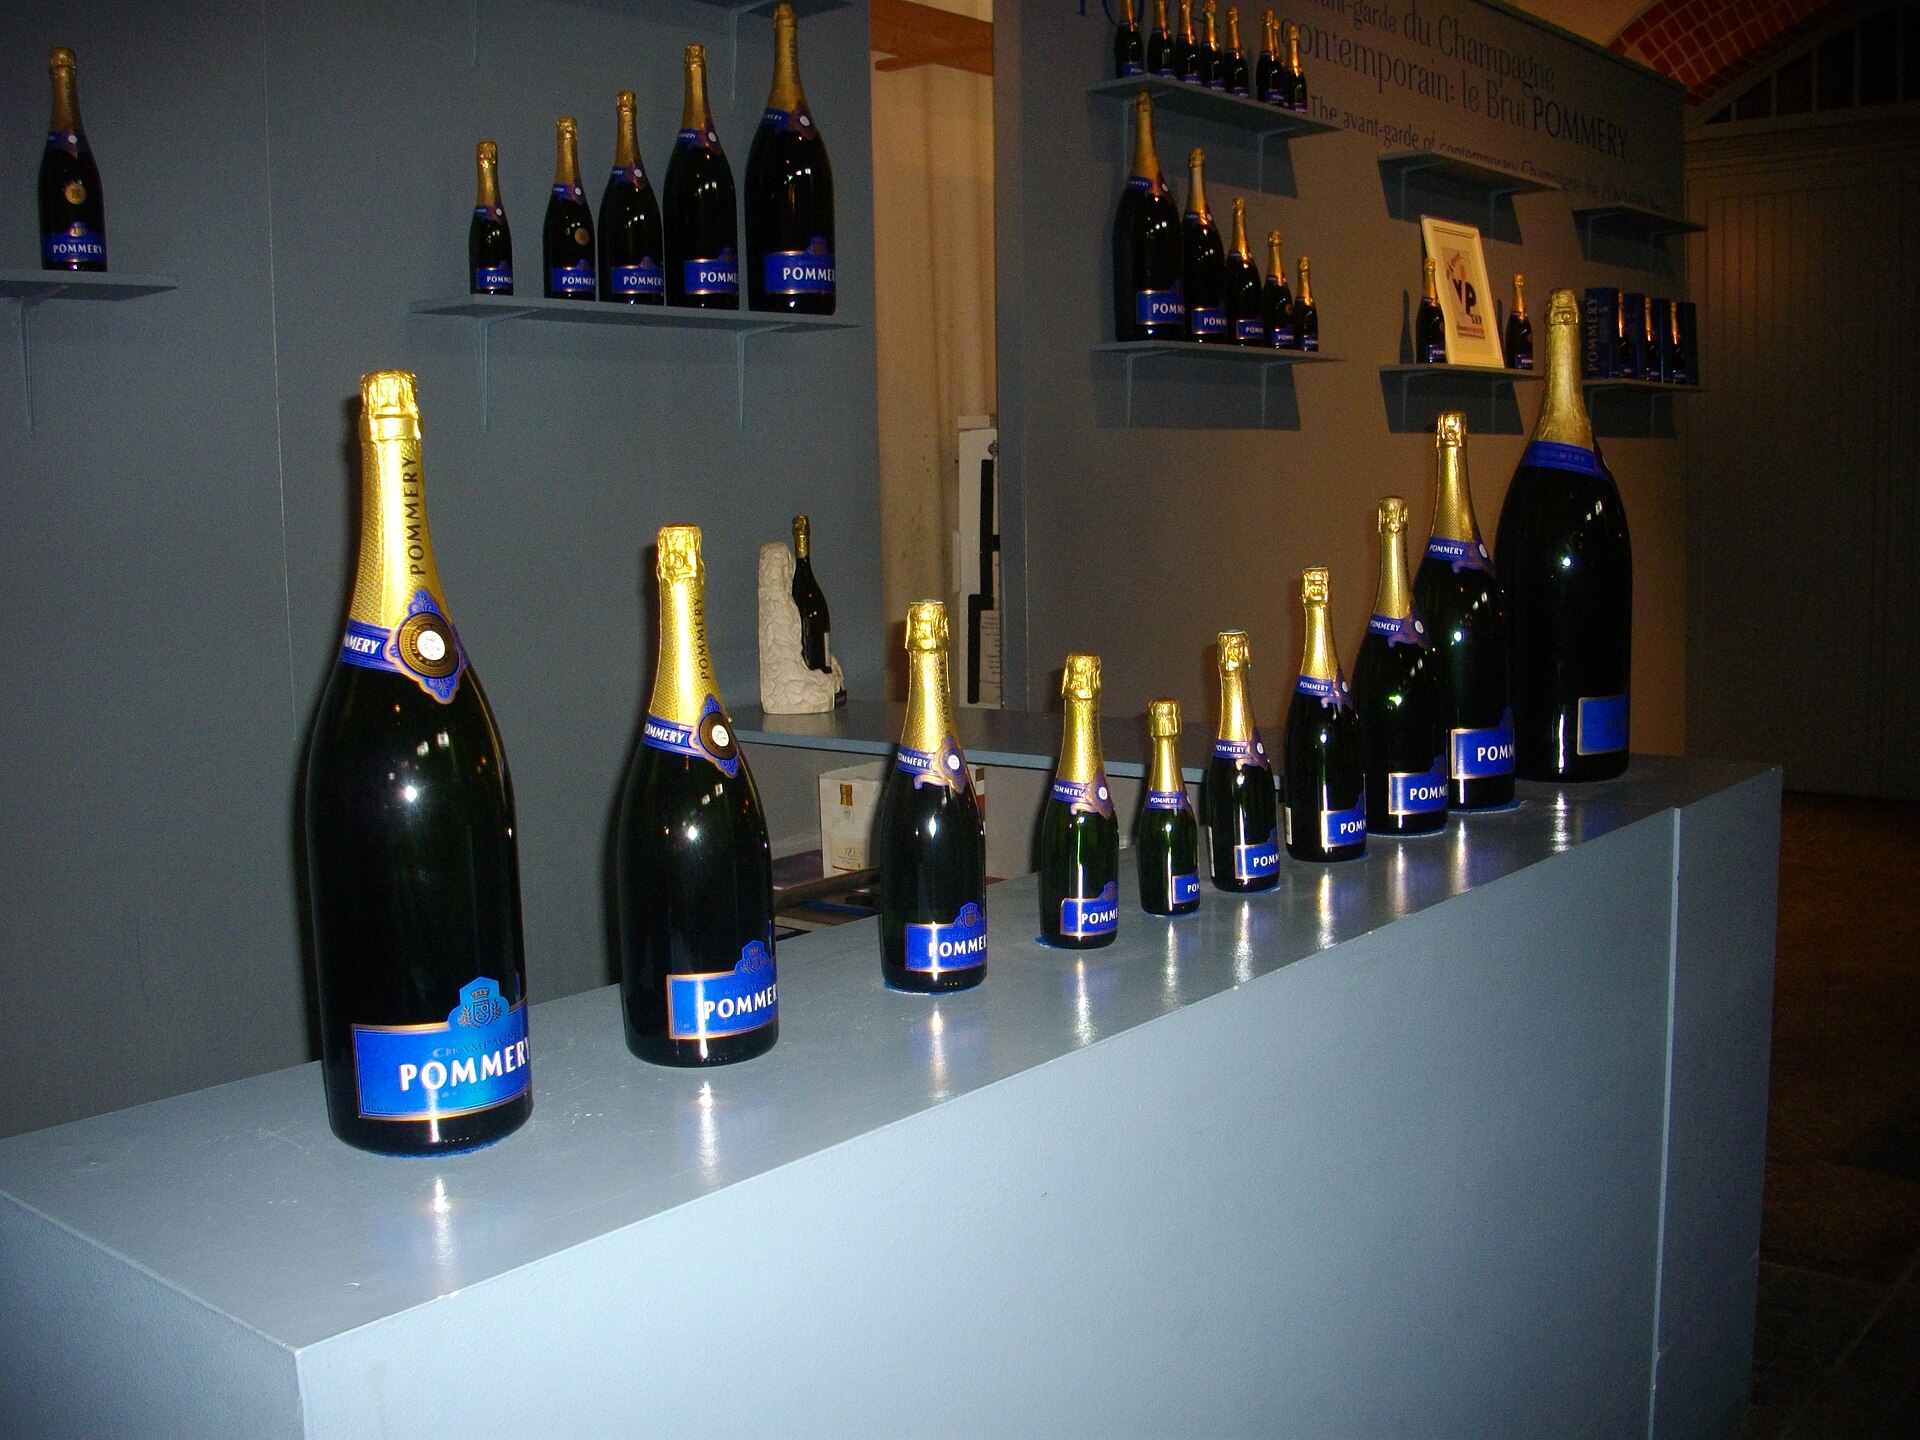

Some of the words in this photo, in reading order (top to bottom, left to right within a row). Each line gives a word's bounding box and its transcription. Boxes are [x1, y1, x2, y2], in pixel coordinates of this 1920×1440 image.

[1403, 0, 1431, 48] du
[1438, 14, 1555, 98] Champagne
[1309, 95, 1338, 121] The
[1343, 112, 1420, 150] avant-garde
[1461, 69, 1480, 113] le
[402, 456, 426, 575] POMMERY
[694, 598, 710, 680] POMMERY
